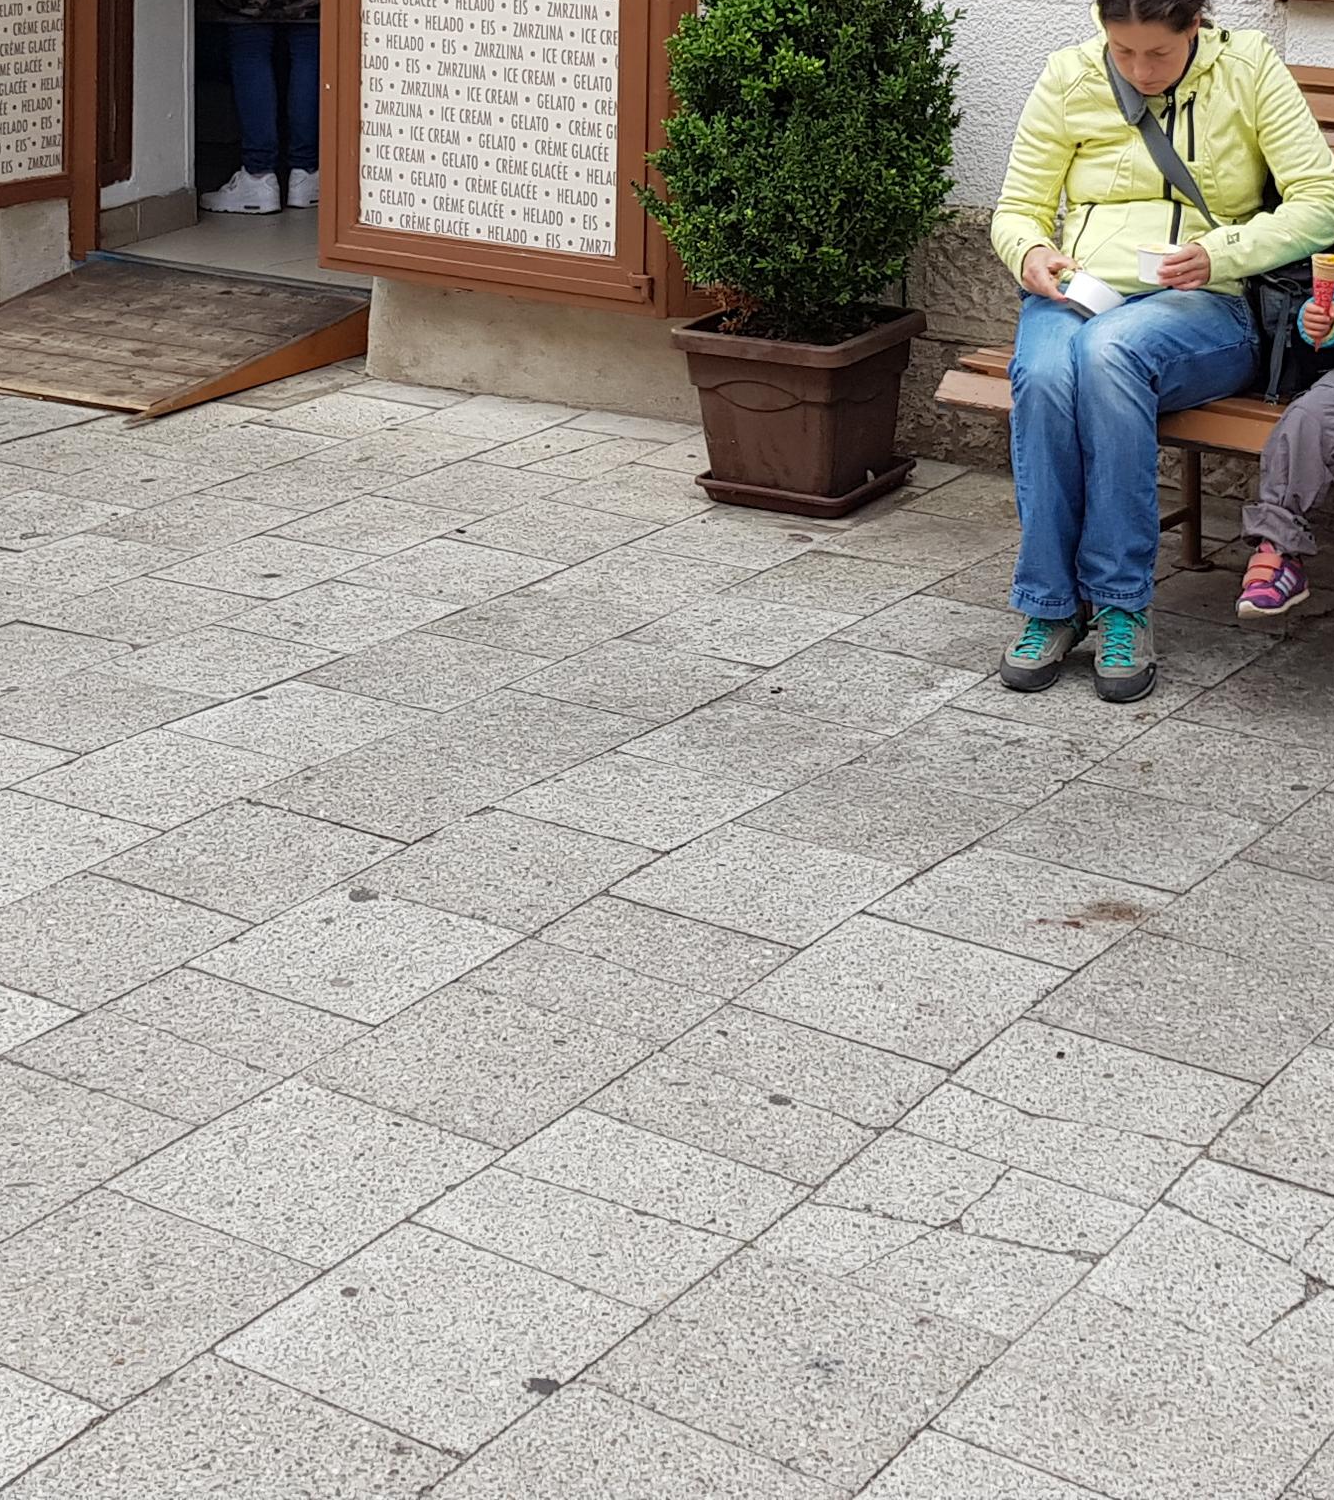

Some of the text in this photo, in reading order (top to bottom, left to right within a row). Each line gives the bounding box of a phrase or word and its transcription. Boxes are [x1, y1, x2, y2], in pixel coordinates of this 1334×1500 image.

[513, 0, 528, 15] EIS
[547, 2, 598, 21] ZMRZLINA
[386, 34, 595, 67] HELADO EIS ZMRZLINA ICE CREAM
[406, 58, 612, 92] EIS ZMRZLINA ICE CREAM GELATO
[376, 144, 390, 160] ICE
[393, 146, 425, 164] CREAM
[442, 152, 478, 170] GELATO
[380, 189, 415, 207] GELATO
[523, 207, 563, 226] HELADO
[583, 214, 598, 231] EIS
